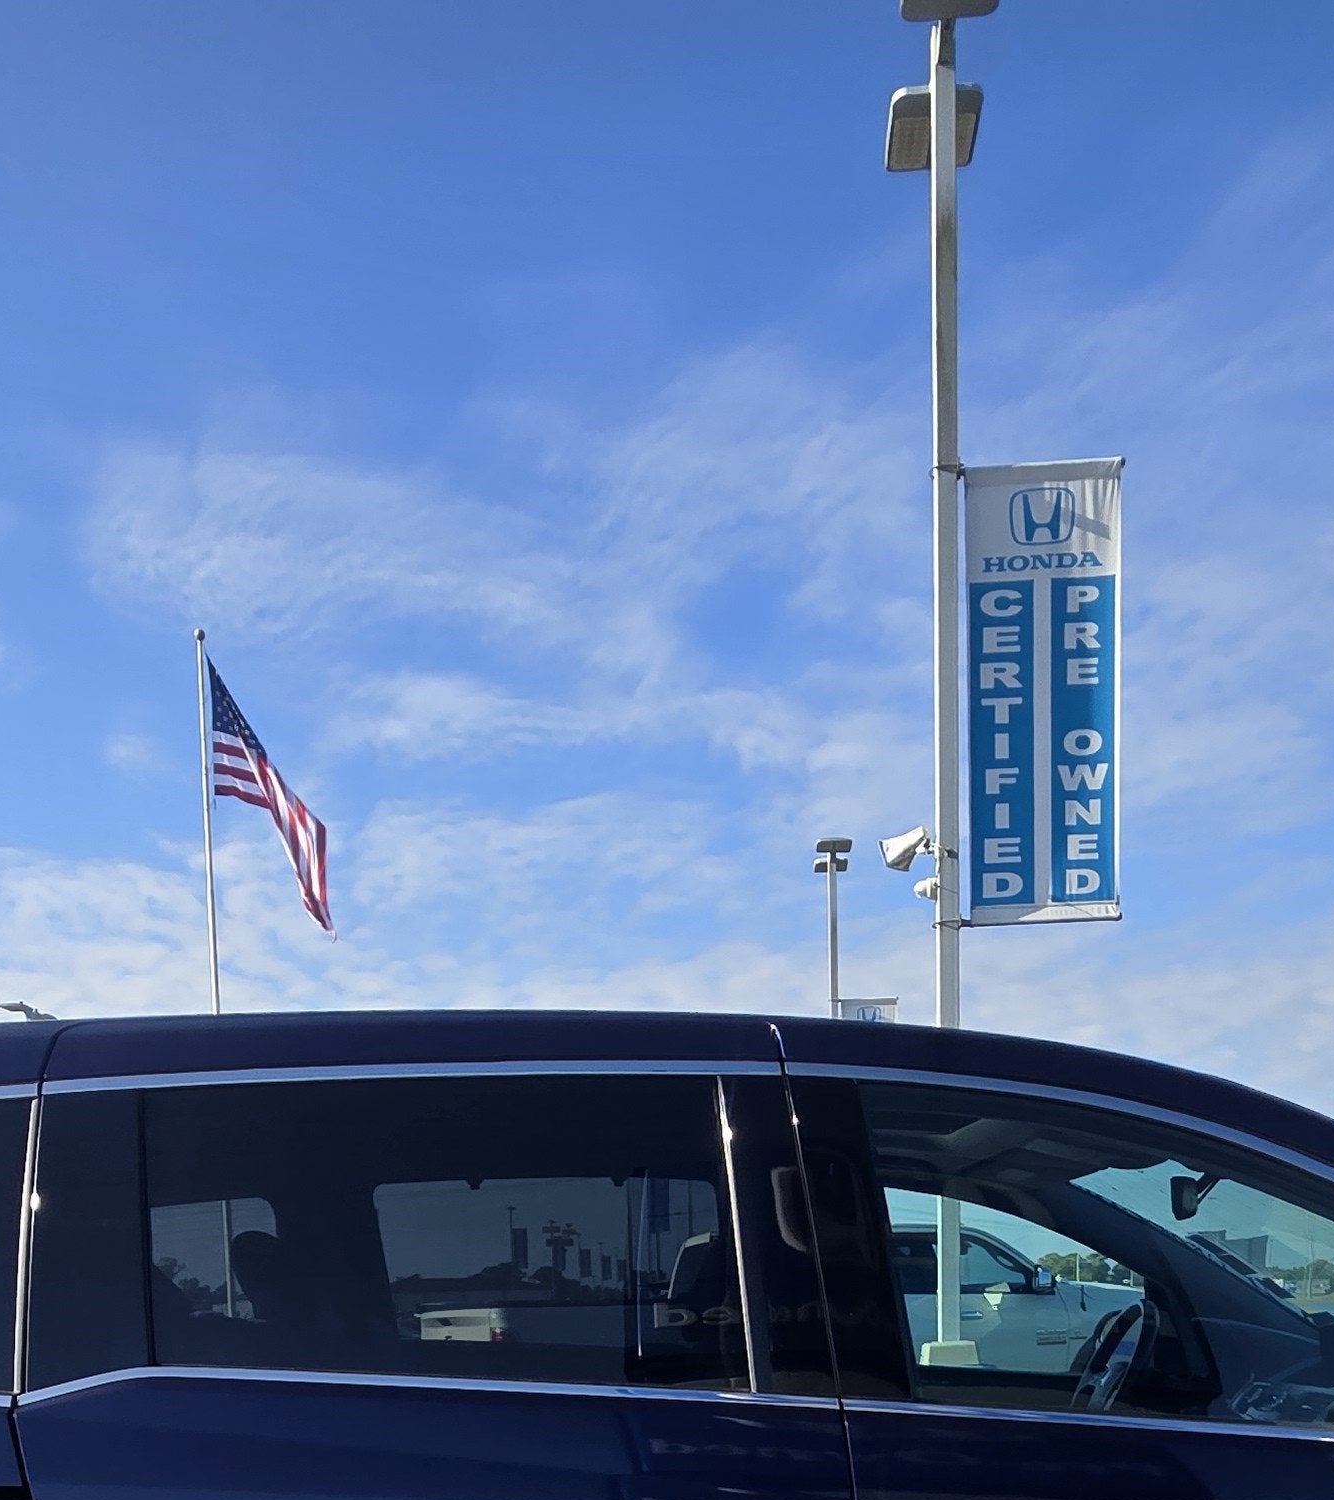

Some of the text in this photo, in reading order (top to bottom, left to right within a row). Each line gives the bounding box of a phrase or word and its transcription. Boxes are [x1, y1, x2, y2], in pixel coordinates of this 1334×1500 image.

[982, 552, 1103, 573] HONDA
[979, 588, 1025, 900] CERTIFIED
[1057, 585, 1109, 896] PRE OWNED
